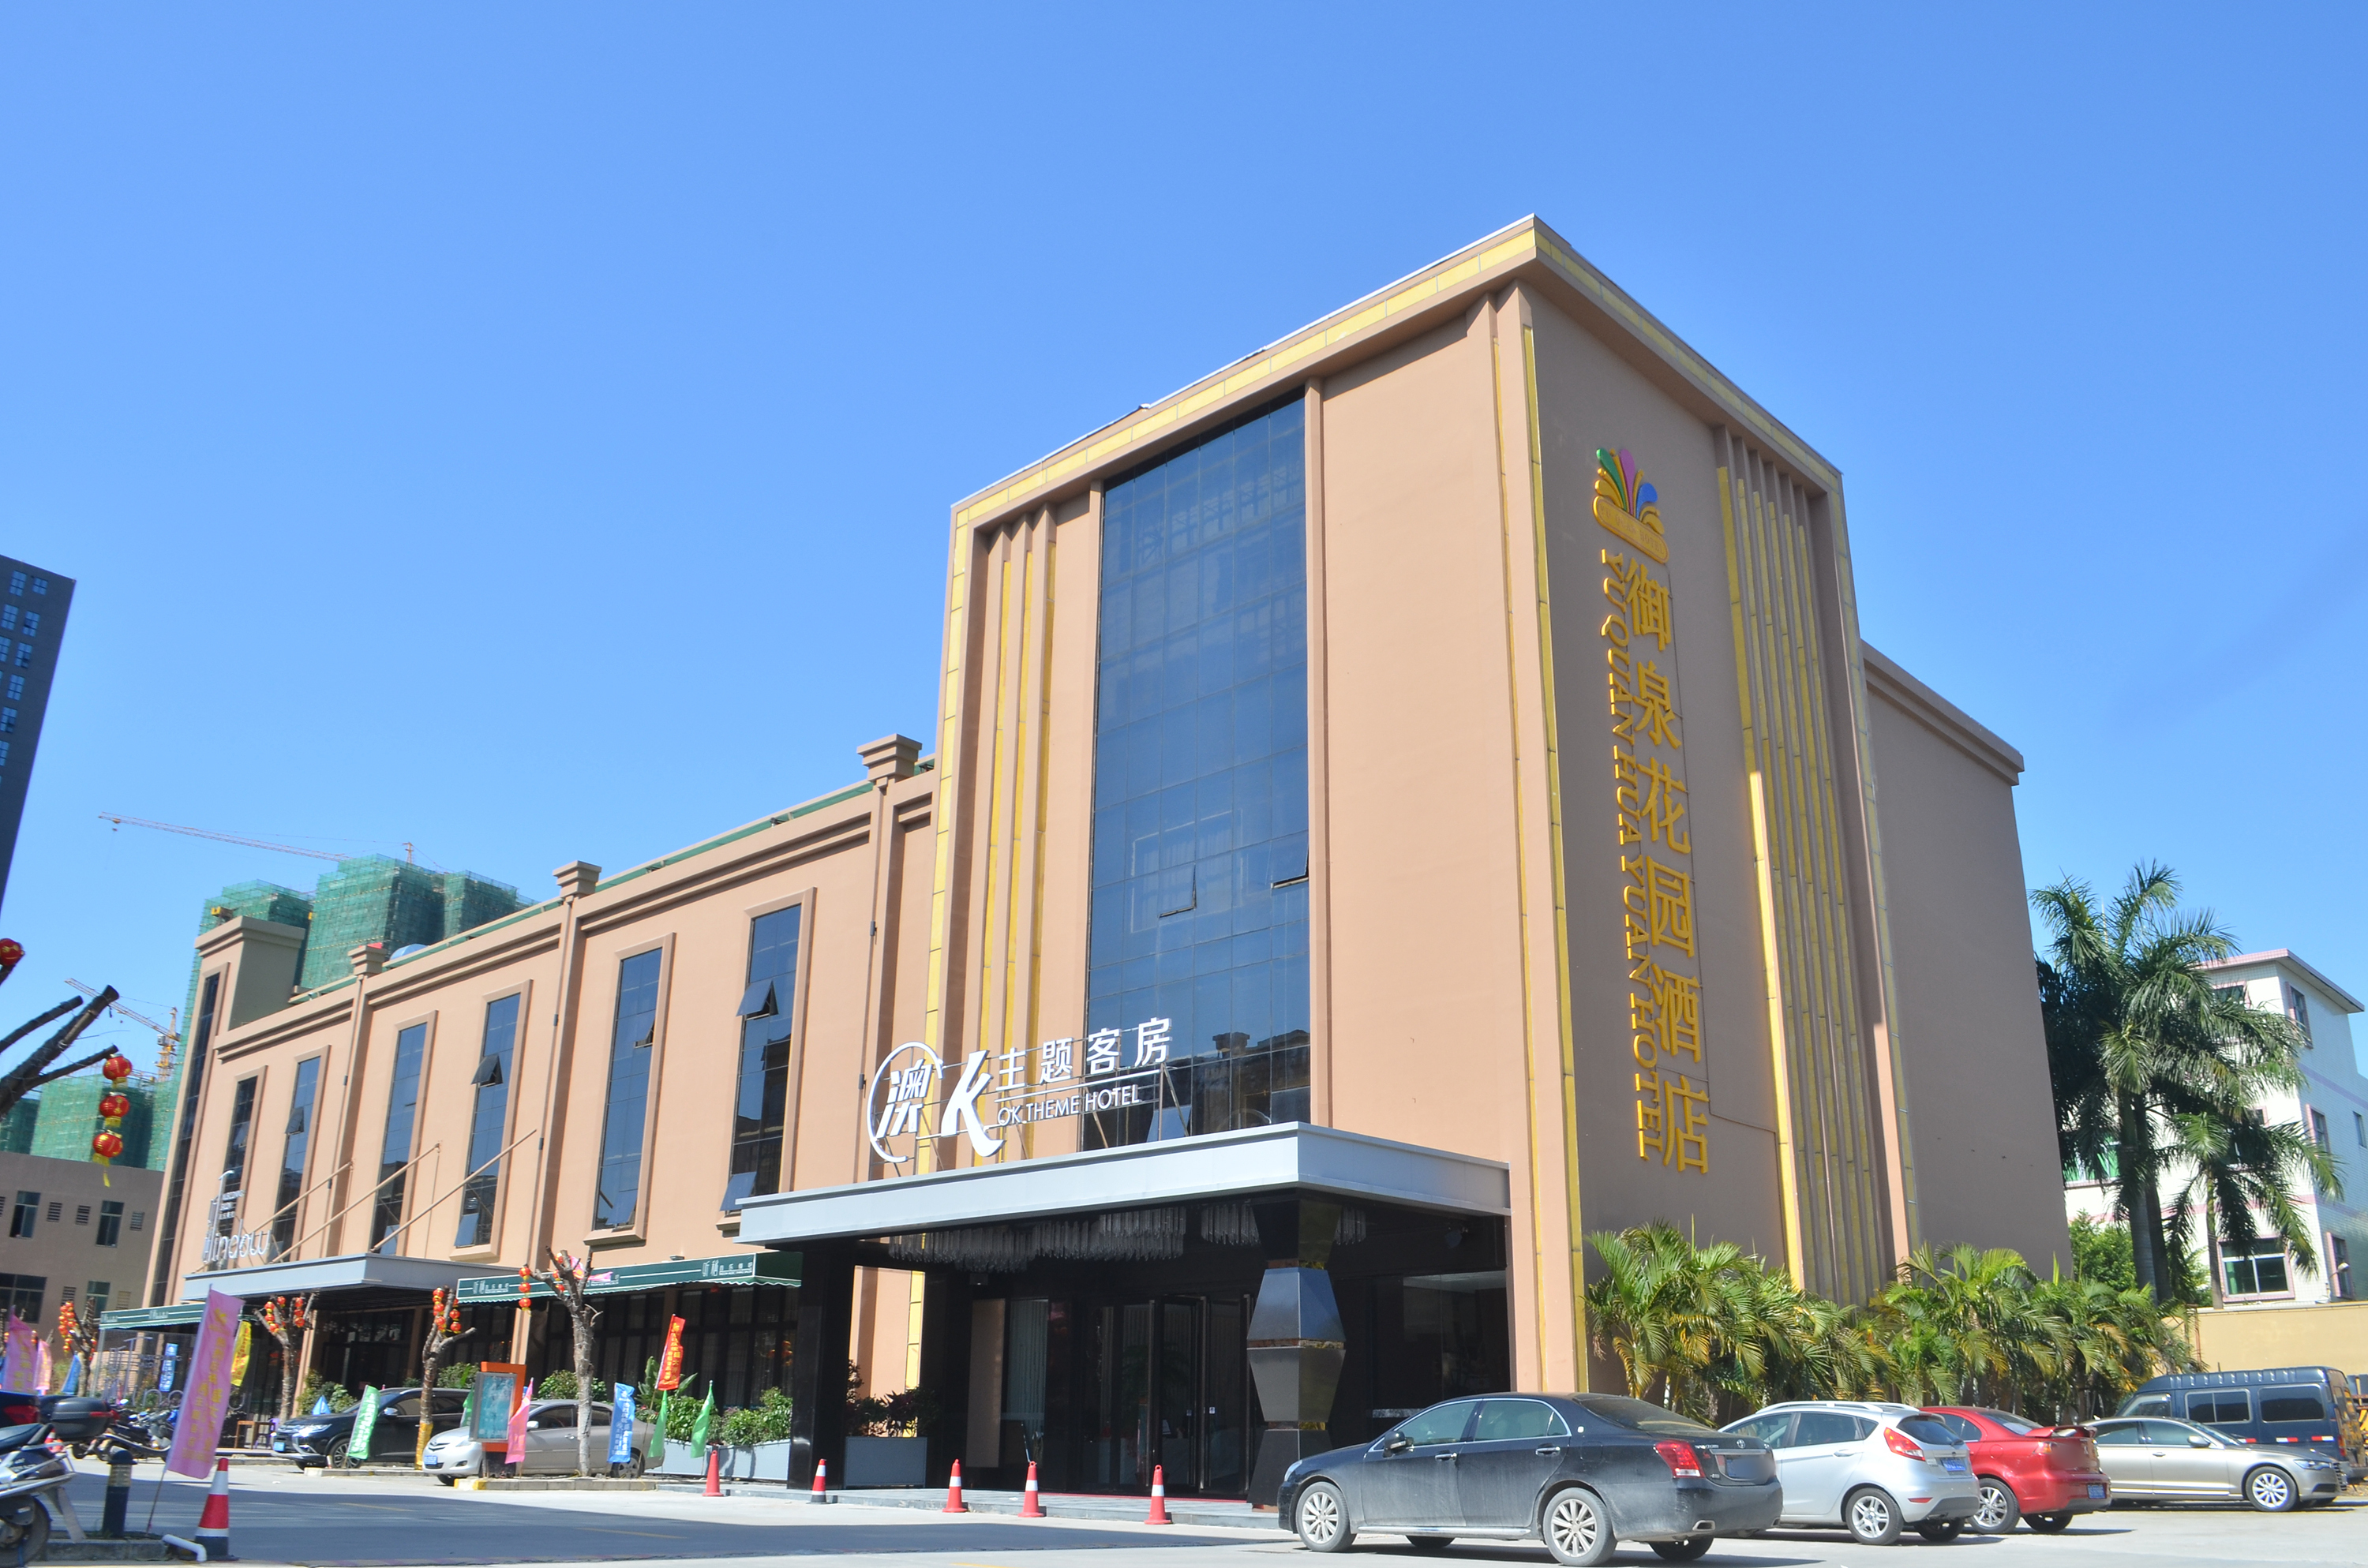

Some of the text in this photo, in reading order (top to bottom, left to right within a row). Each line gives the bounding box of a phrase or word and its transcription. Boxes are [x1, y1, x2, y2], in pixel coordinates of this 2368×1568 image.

[1640, 530, 1665, 555] HOTEL
[1624, 557, 1710, 1174] 御泉花园酒店
[995, 1016, 1173, 1091] 主题客房
[1630, 992, 1663, 1161] HOTEL
[997, 1083, 1143, 1127] OK THEME HOTEL
